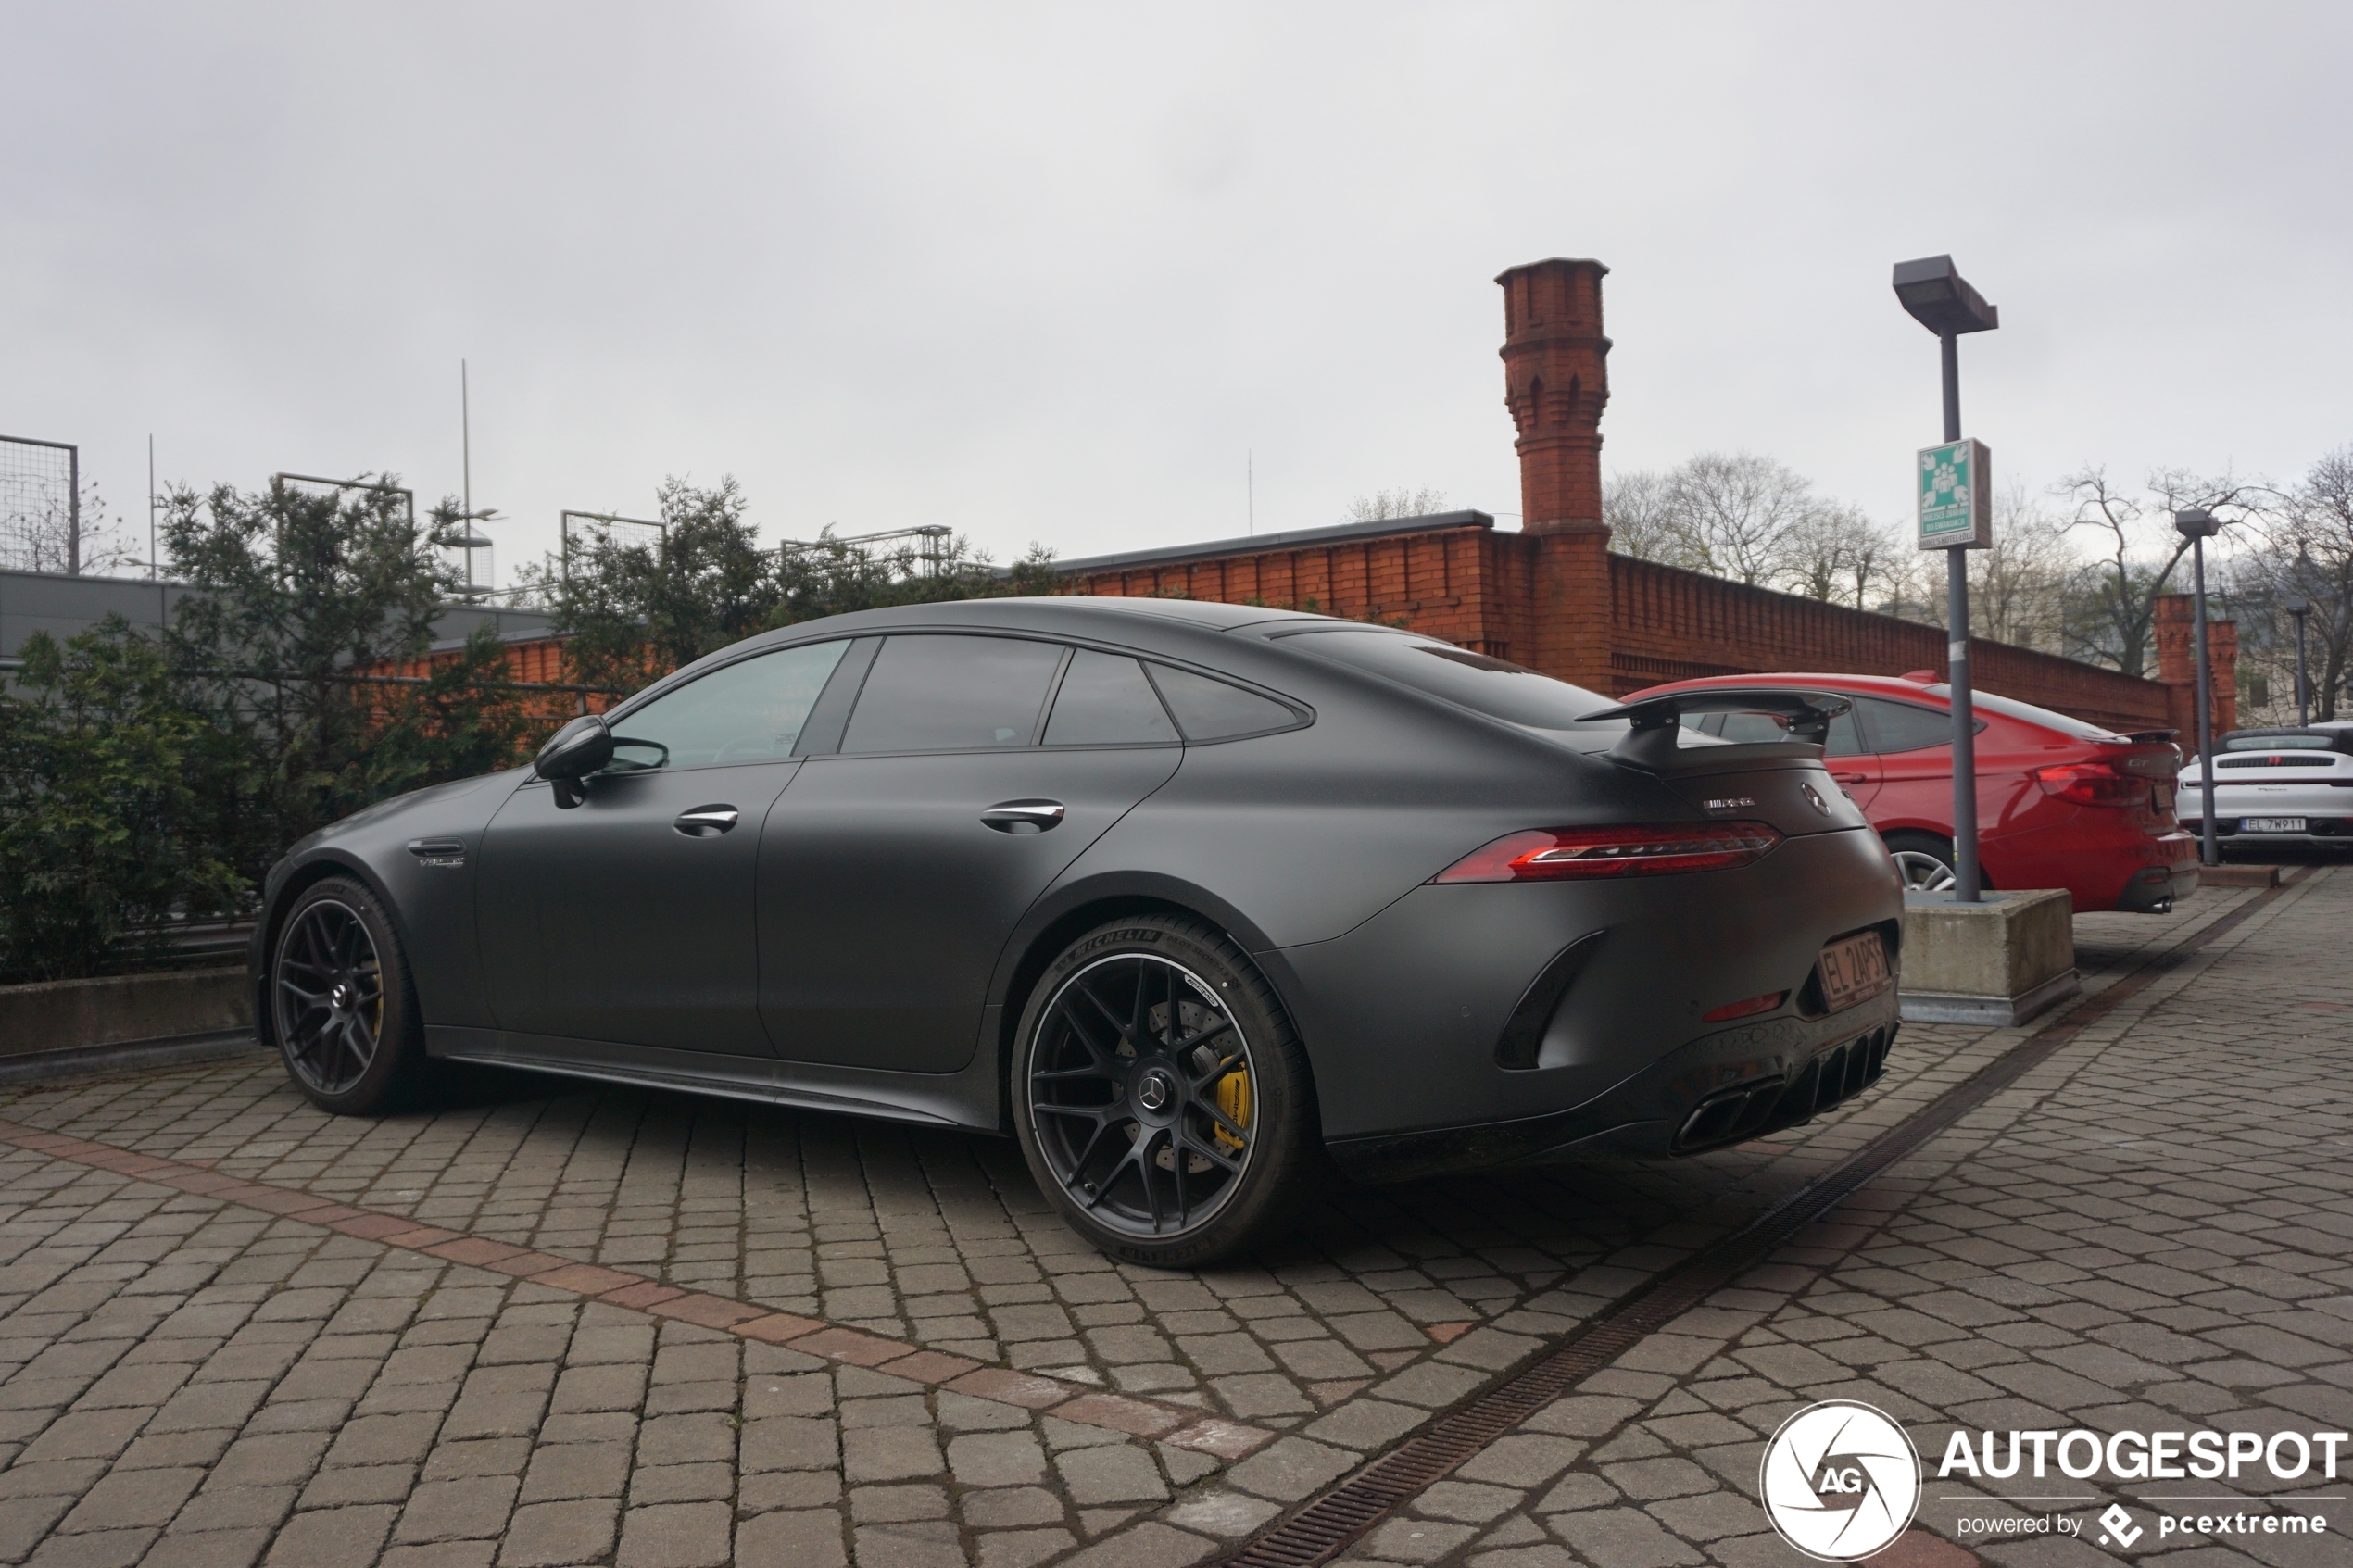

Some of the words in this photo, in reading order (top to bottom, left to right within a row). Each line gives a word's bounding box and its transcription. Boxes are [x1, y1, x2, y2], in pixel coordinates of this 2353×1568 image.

[1924, 511, 1945, 521] MIEJSCE
[1926, 523, 1934, 532] DO
[1934, 518, 1965, 529] EWAKUACJI
[1919, 536, 1941, 547] ANDEL'S
[1942, 534, 1958, 544] HOTEL
[2128, 759, 2149, 767] GT
[1722, 797, 1755, 807] AMG
[2249, 819, 2262, 829] EL
[2267, 819, 2302, 829] 7W911
[1075, 930, 1156, 957] MICHELIN
[1167, 935, 1192, 948] PILOT
[1192, 947, 1220, 970] SPORT
[1823, 951, 1850, 994] EL
[1846, 936, 1885, 986] 2AP55
